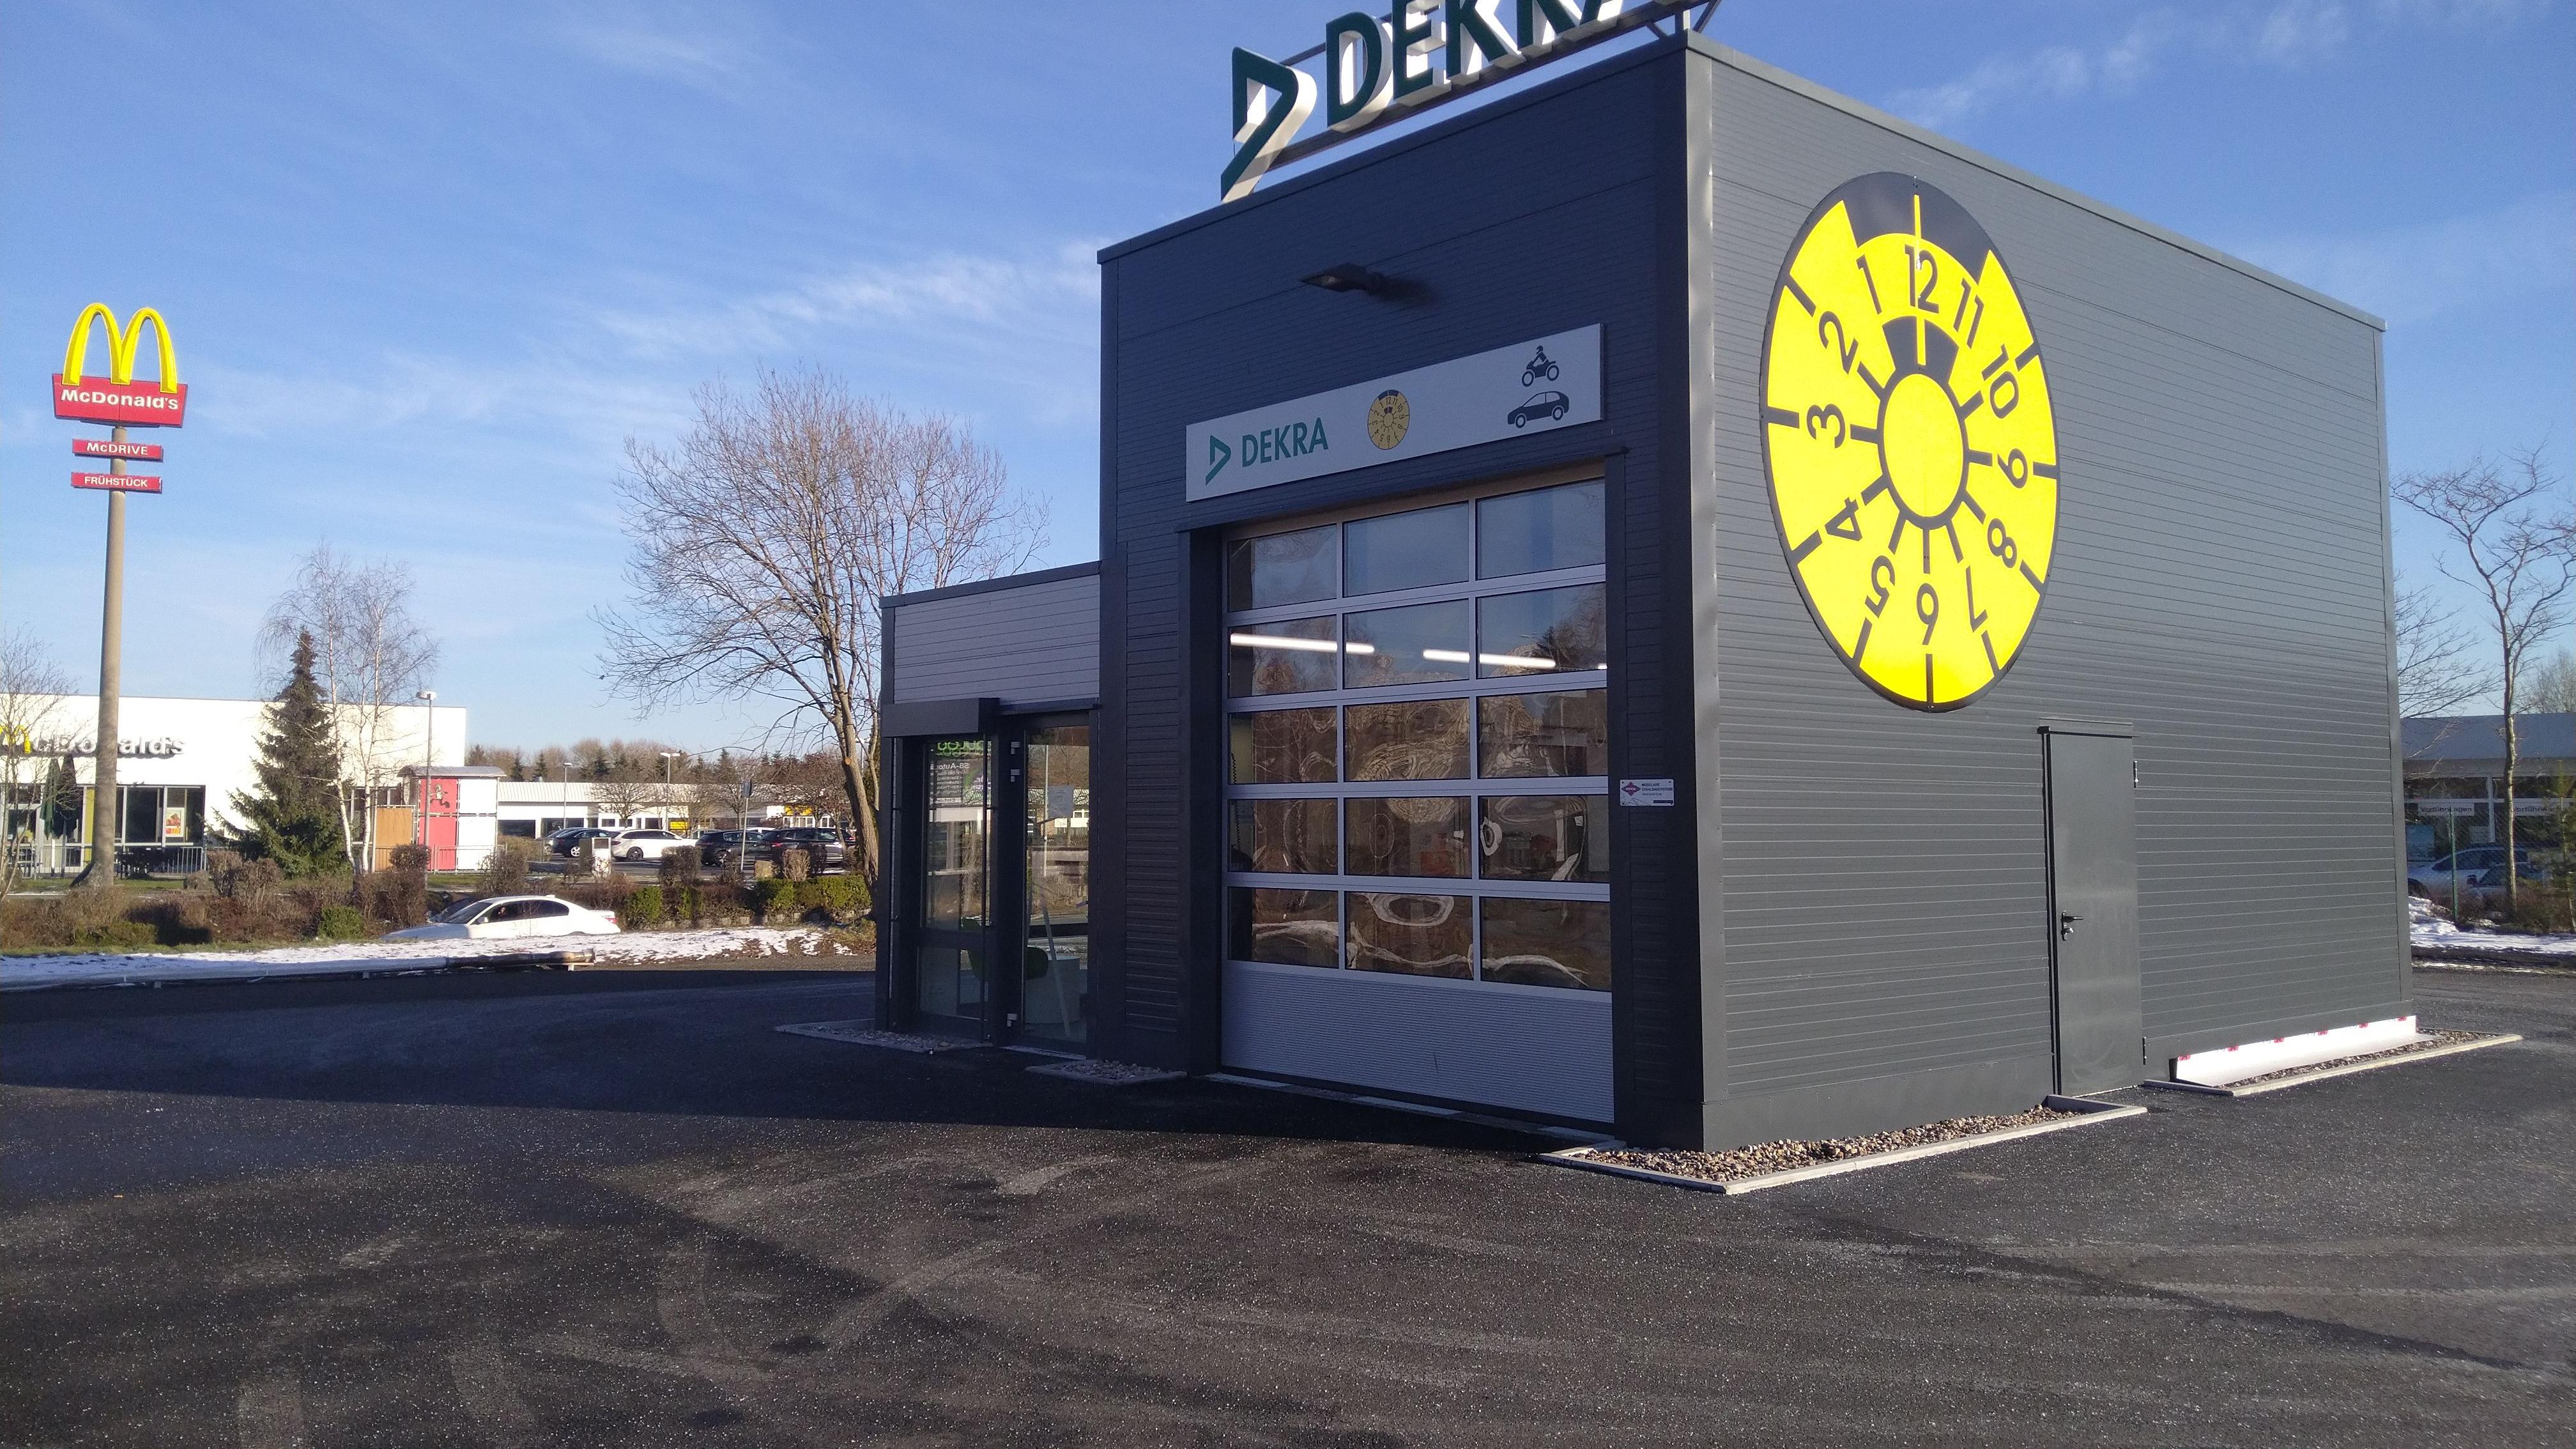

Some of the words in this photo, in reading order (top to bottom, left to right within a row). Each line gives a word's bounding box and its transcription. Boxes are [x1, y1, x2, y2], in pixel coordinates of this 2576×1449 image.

[1325, 0, 1620, 132] DEK
[1857, 255, 1882, 314] 1
[1905, 244, 1940, 310] 12
[1952, 278, 1986, 348] 11
[1818, 310, 1860, 374] 2
[61, 388, 179, 410] McDonald's
[1981, 343, 2020, 420] 10
[86, 442, 148, 456] McDRIVE
[1241, 417, 1329, 468] DEKRA
[1806, 402, 1846, 448] 3
[84, 475, 148, 488] FRÜHSTÜCK
[1997, 447, 2028, 489] 9
[1825, 496, 1862, 542] 4
[1986, 518, 2018, 570] 8
[1864, 554, 1897, 618] 5
[1915, 582, 1940, 645] 6
[1964, 565, 1988, 632] 7
[0, 724, 186, 756] McDoald's
